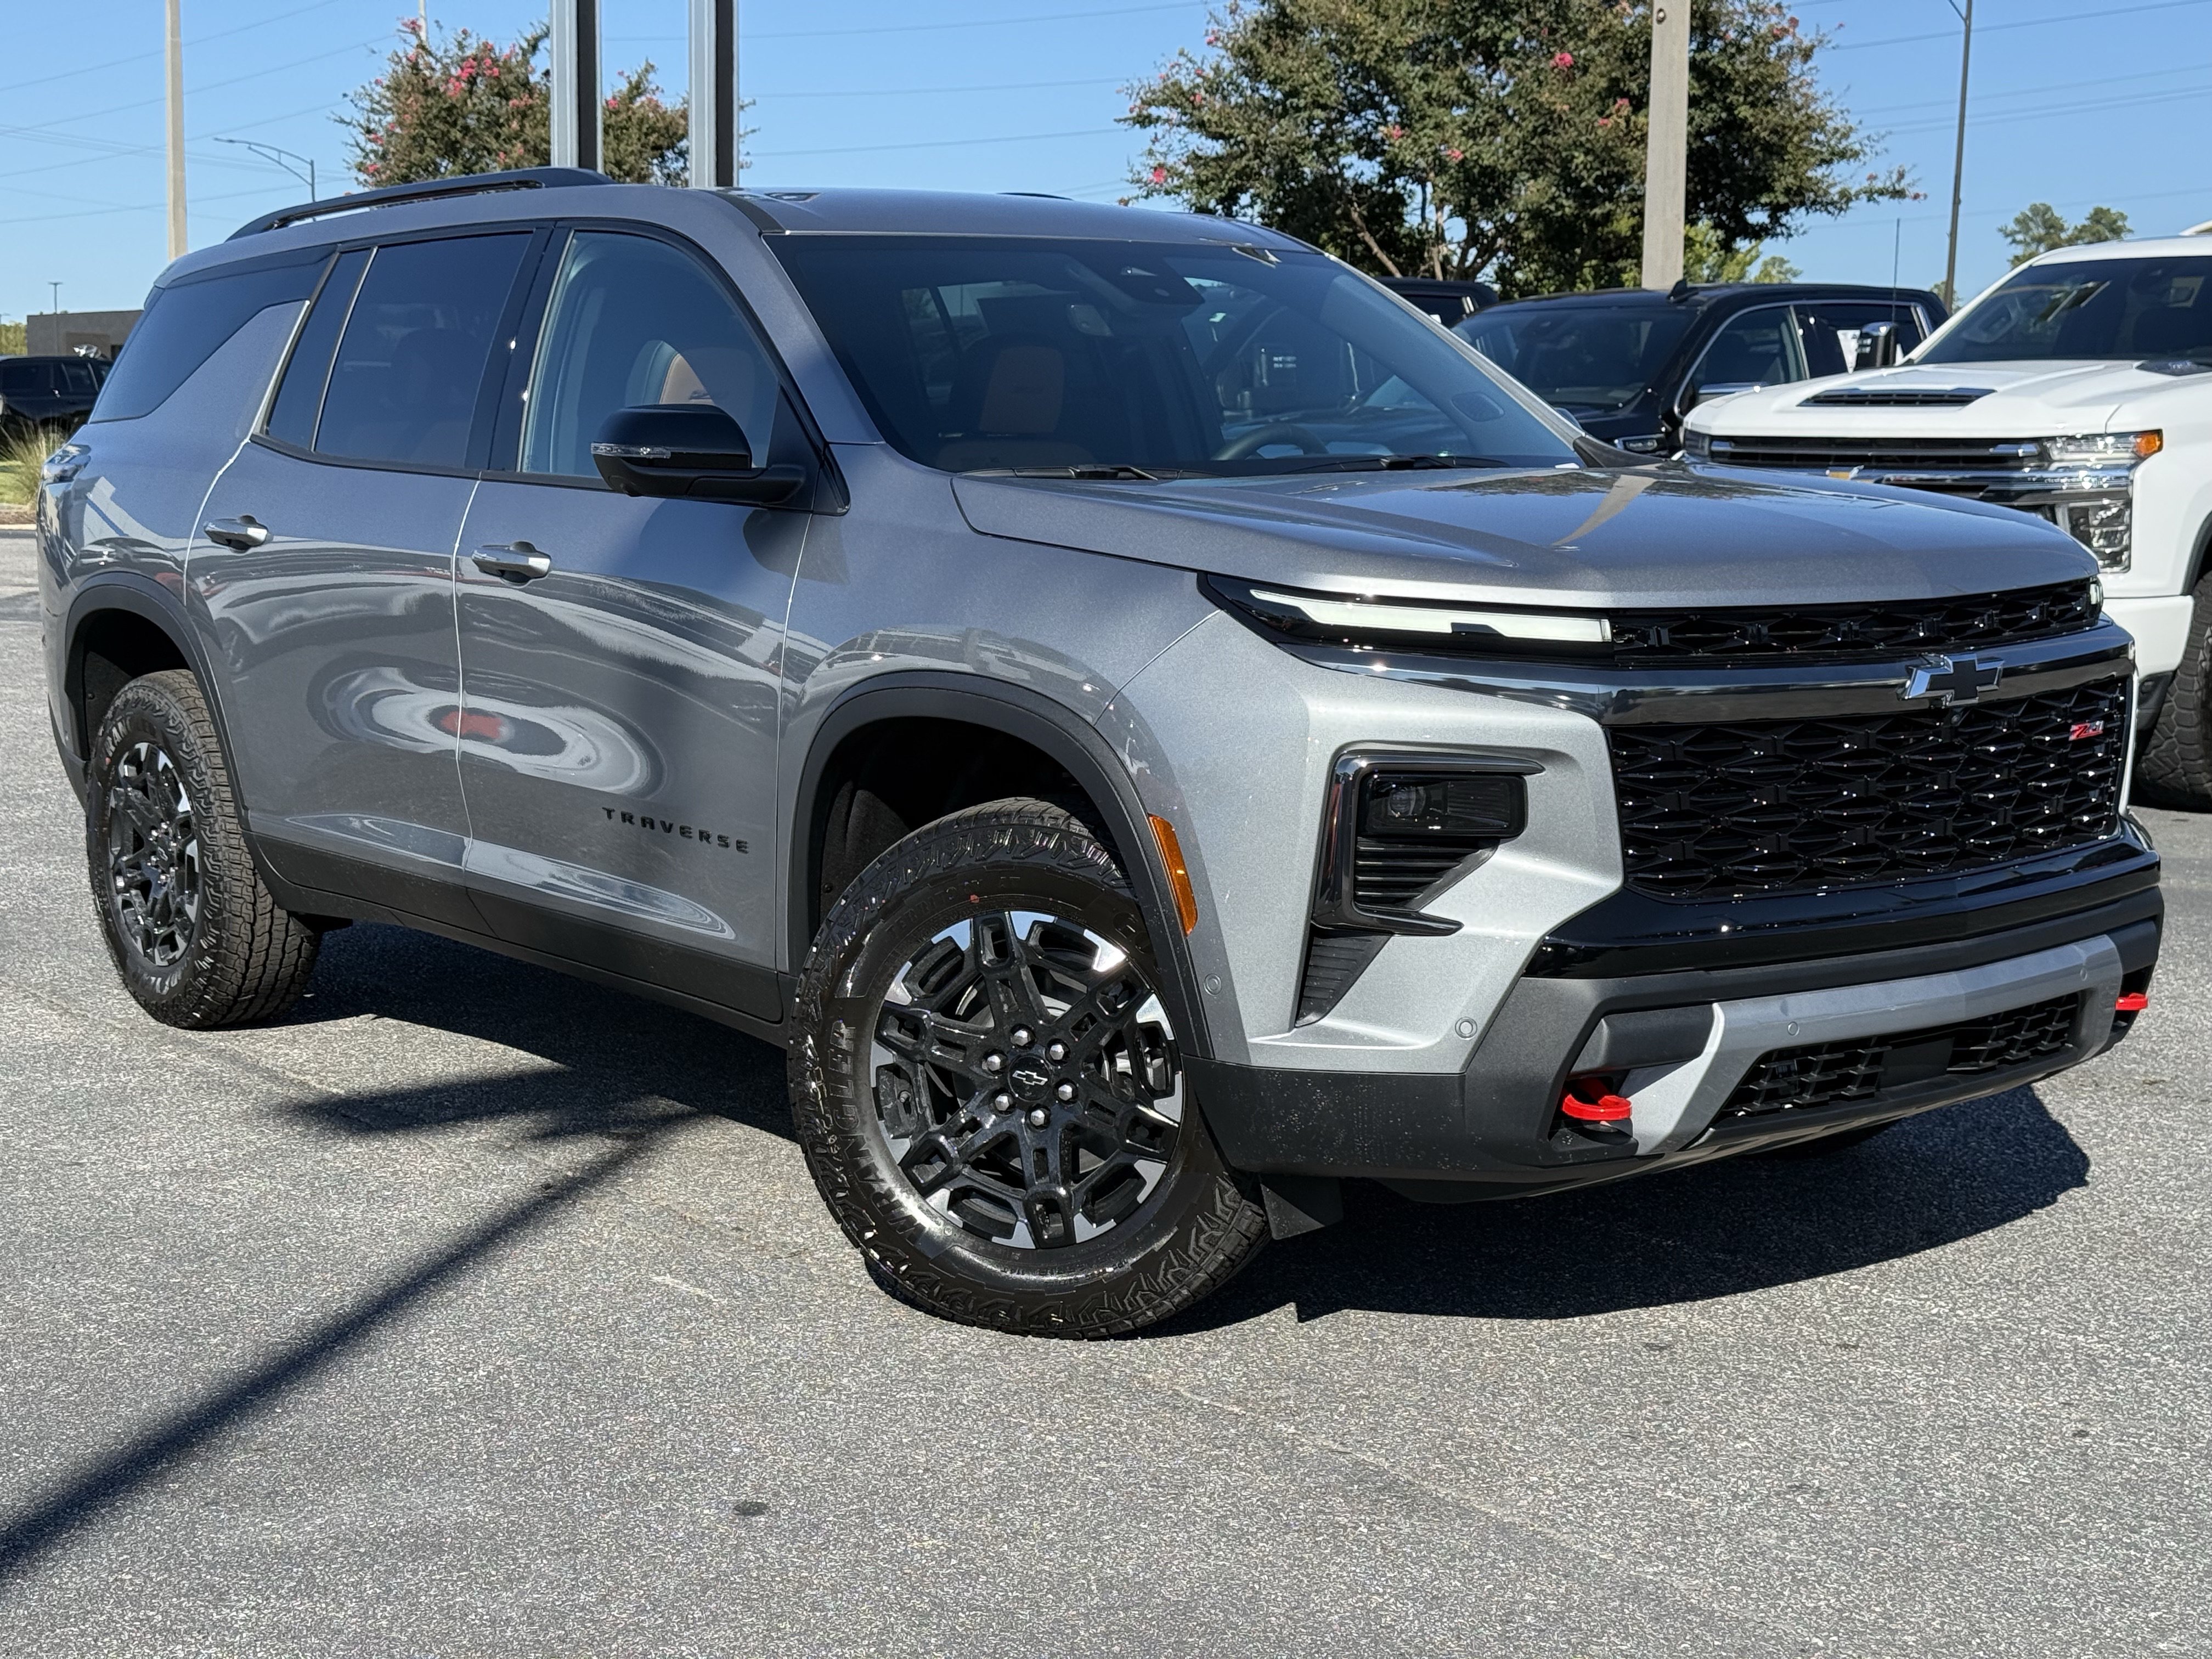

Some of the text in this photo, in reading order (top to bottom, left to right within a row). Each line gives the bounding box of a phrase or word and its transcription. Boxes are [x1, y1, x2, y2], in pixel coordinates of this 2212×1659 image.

[2068, 720, 2105, 741] Z71
[602, 807, 749, 854] TRAVERSE
[827, 1019, 933, 1255] WRANGLER
